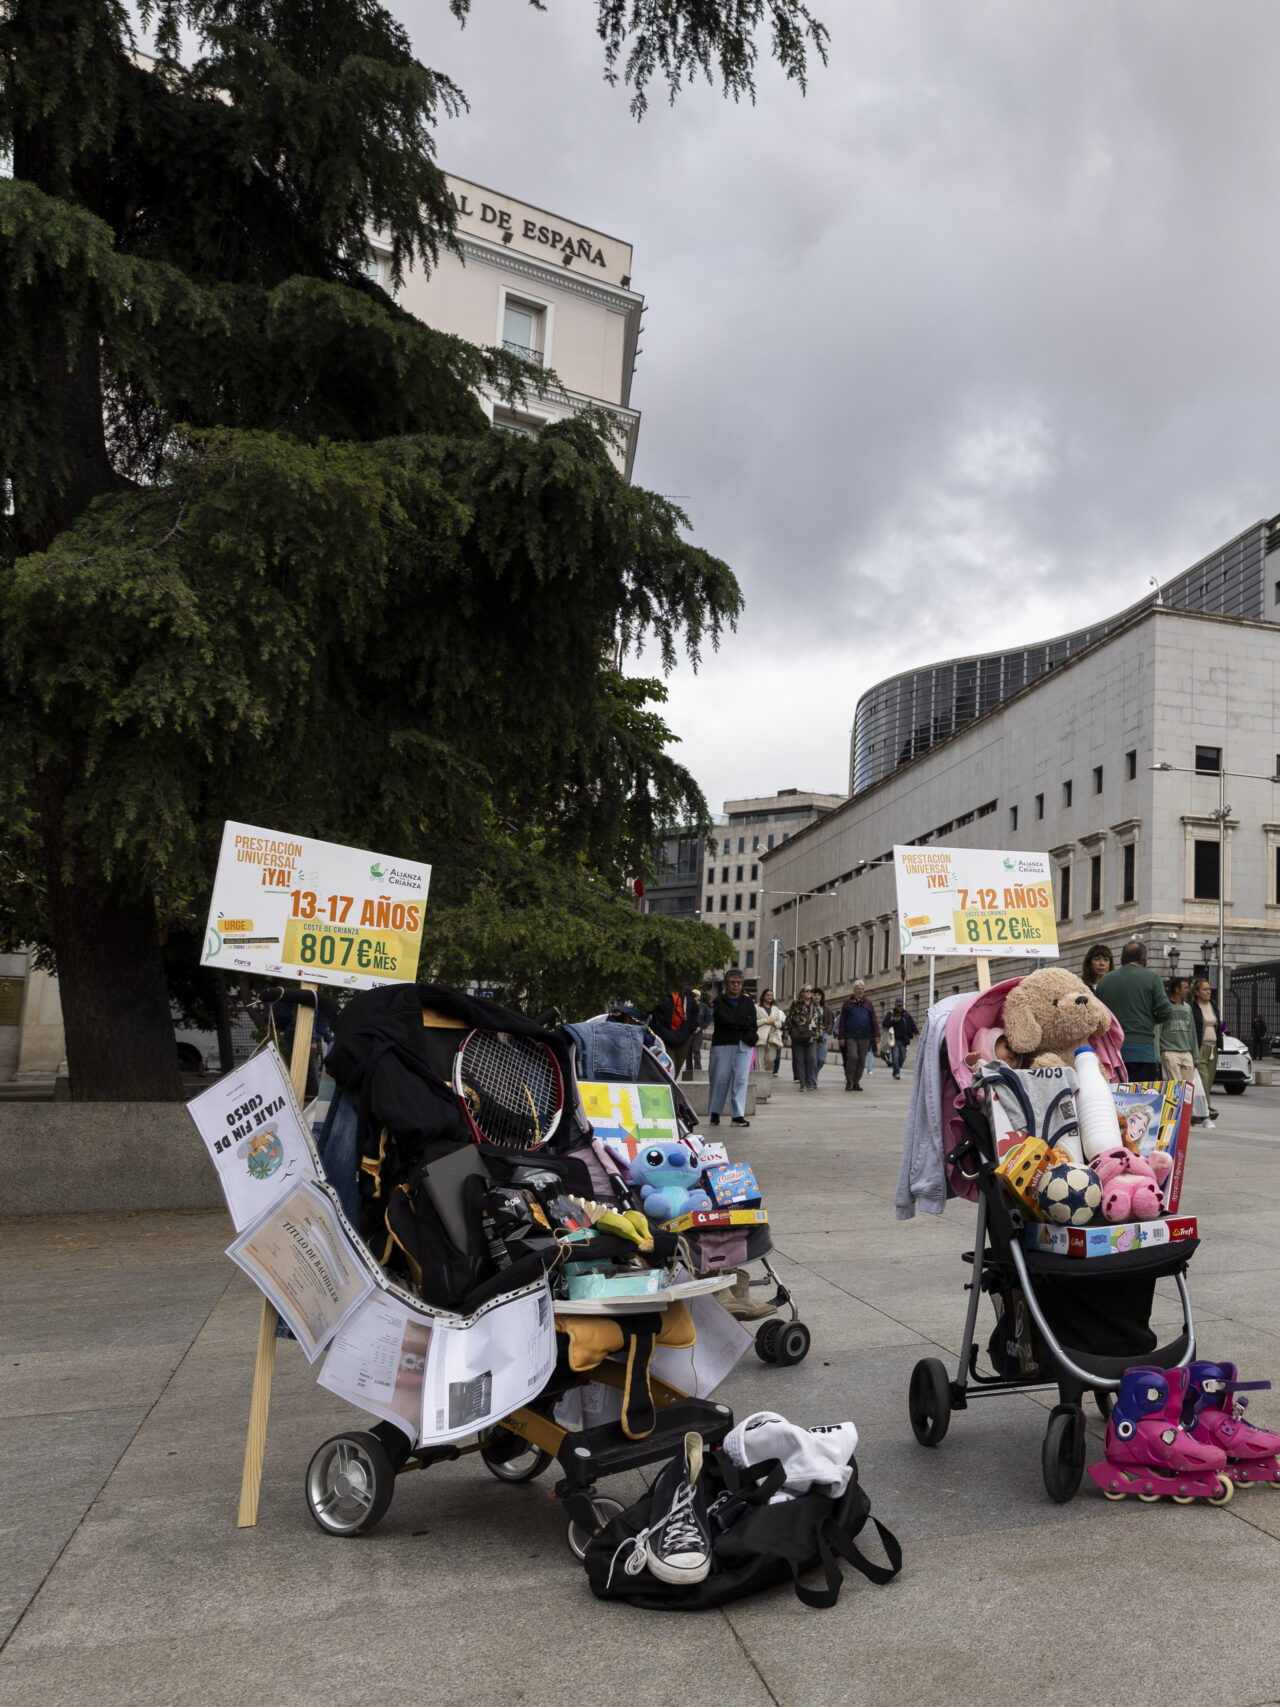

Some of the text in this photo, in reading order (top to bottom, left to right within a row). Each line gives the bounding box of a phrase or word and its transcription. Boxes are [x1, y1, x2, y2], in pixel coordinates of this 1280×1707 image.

[480, 203, 512, 231] DE
[523, 219, 607, 268] ESPAÑA
[234, 834, 302, 857] PRESTACIÓN
[236, 848, 297, 870] UNIVERSAL
[902, 852, 951, 864] PRESTACIÓN
[261, 867, 292, 888] ¡YA!
[390, 868, 422, 882] ALIANZA
[905, 864, 950, 874] UNIVERSAL
[388, 876, 422, 890] CRIANZA
[926, 874, 949, 889] ¡YA!
[957, 883, 1048, 910] 7-12 AÑOS
[290, 890, 420, 933] 13-17 AÑOS
[224, 920, 246, 931] URGE
[303, 923, 322, 931] COSTE
[966, 917, 1022, 942] 812€
[1021, 916, 1032, 928] AL
[1023, 928, 1042, 939] MES
[300, 933, 388, 969] 807€ AL
[373, 955, 397, 971] MES
[226, 1094, 263, 1126] CURSO
[213, 1095, 287, 1154] VIAJE FIN DE
[1179, 1227, 1194, 1236] Trefl
[282, 1220, 309, 1251] TÍTULO
[306, 1249, 319, 1262] DE
[313, 1257, 340, 1304] BACHILLER
